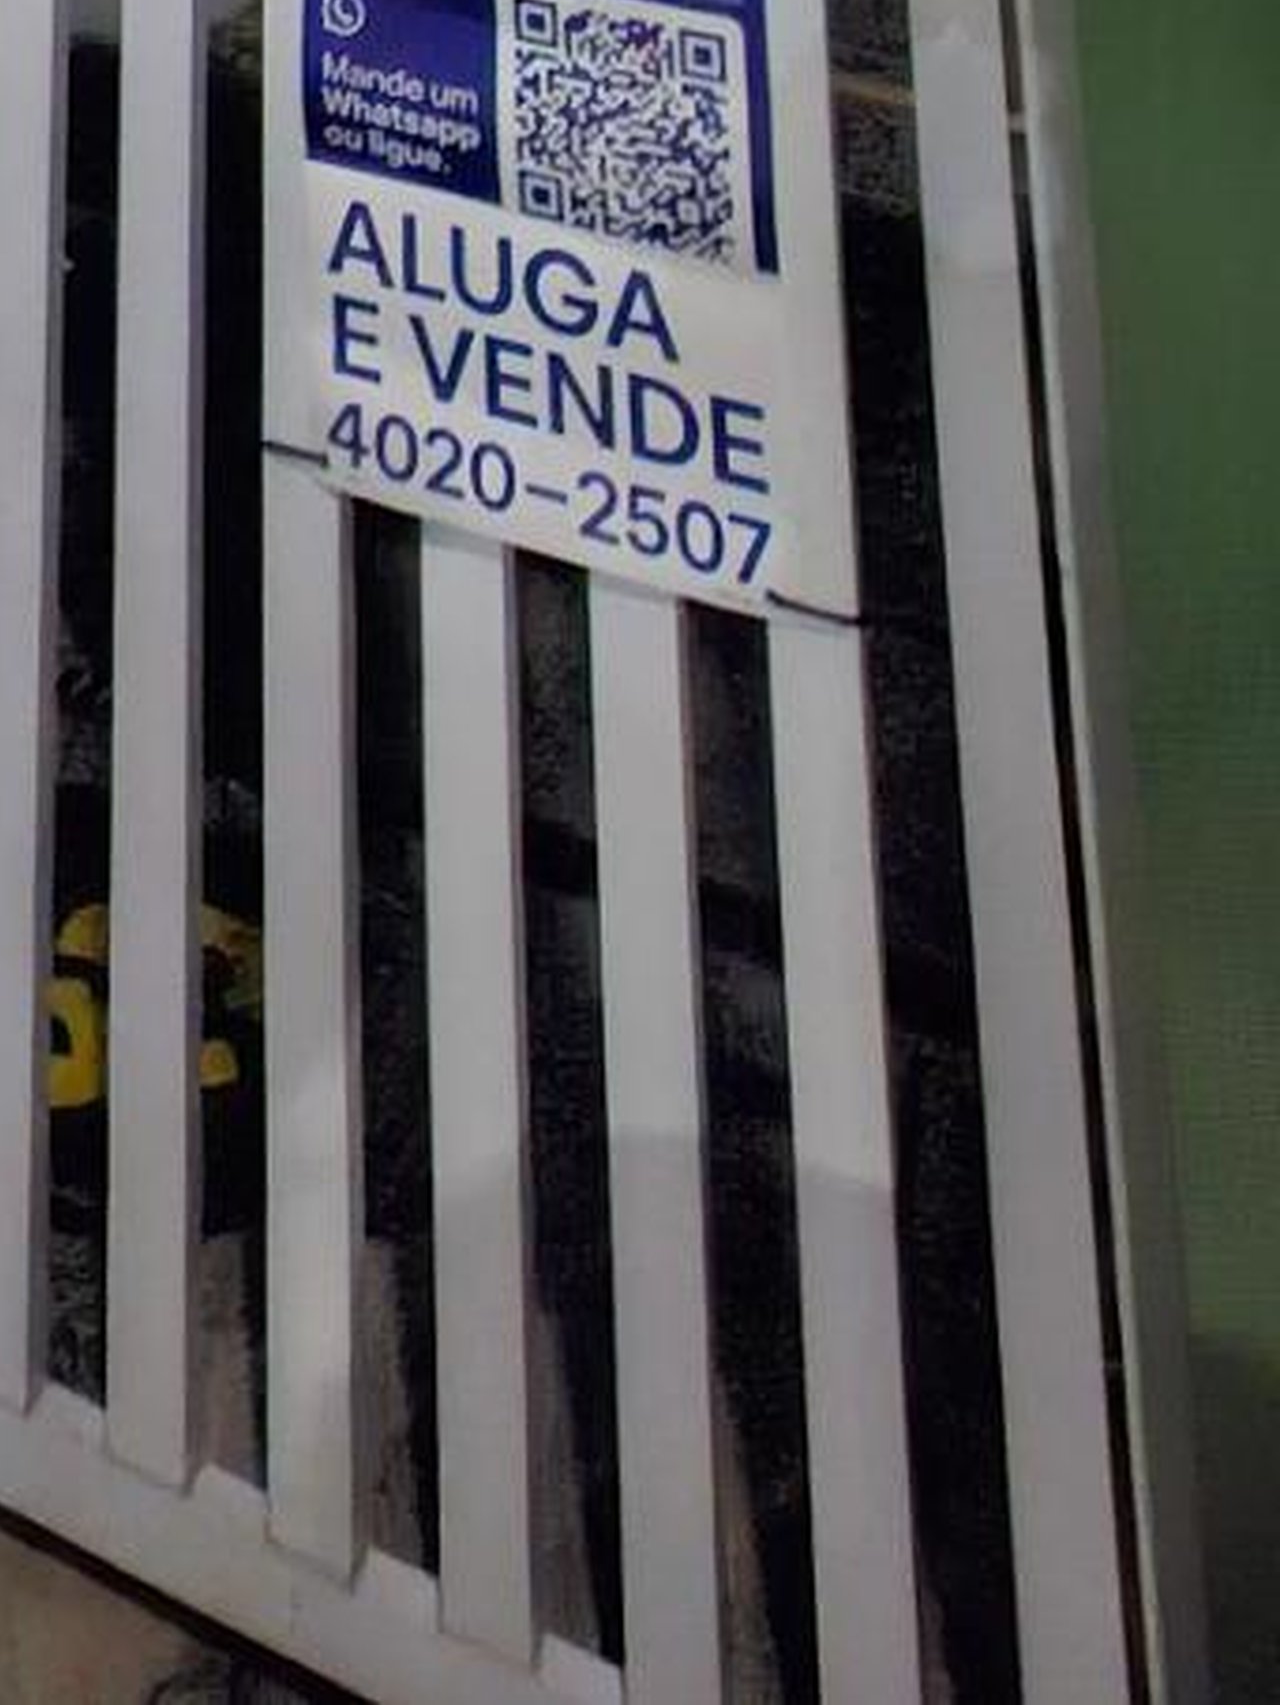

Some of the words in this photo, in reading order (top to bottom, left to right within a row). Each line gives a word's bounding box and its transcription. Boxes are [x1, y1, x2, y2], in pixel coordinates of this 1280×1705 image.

[322, 50, 425, 102] Mande
[430, 82, 479, 114] um
[322, 86, 481, 152] Whatsapp
[324, 124, 363, 152] ou
[368, 130, 451, 174] ligue.
[327, 200, 680, 364] ALUGA
[332, 293, 383, 384] E
[408, 314, 770, 495] VENDE
[327, 403, 772, 584] 4020-2507
